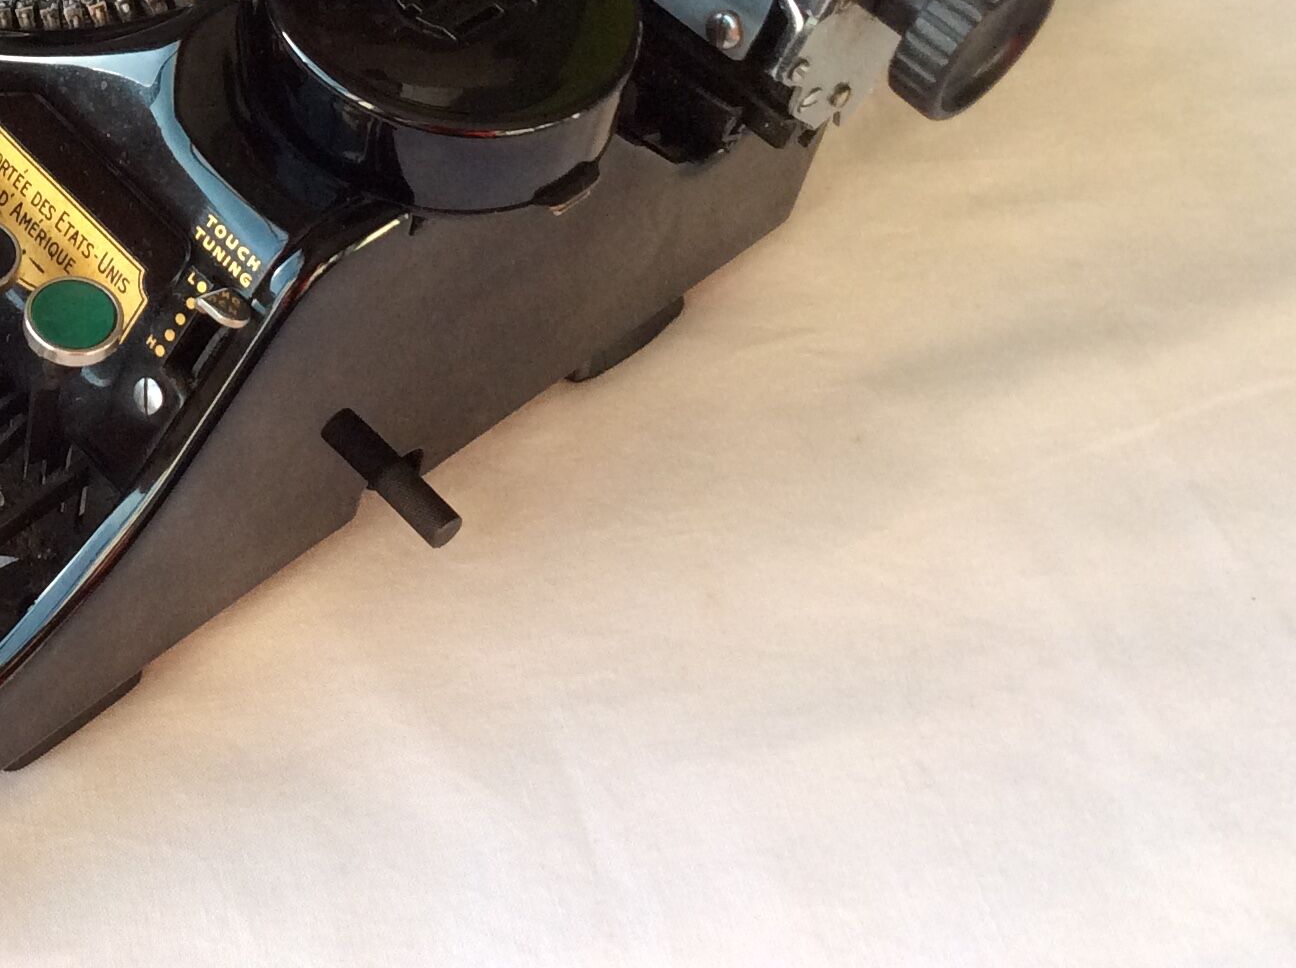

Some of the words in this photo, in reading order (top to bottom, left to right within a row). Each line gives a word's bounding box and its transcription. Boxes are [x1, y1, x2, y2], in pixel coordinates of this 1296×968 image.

[30, 190, 57, 221] DES
[194, 225, 253, 288] TUNING
[206, 213, 262, 272] TOUCH
